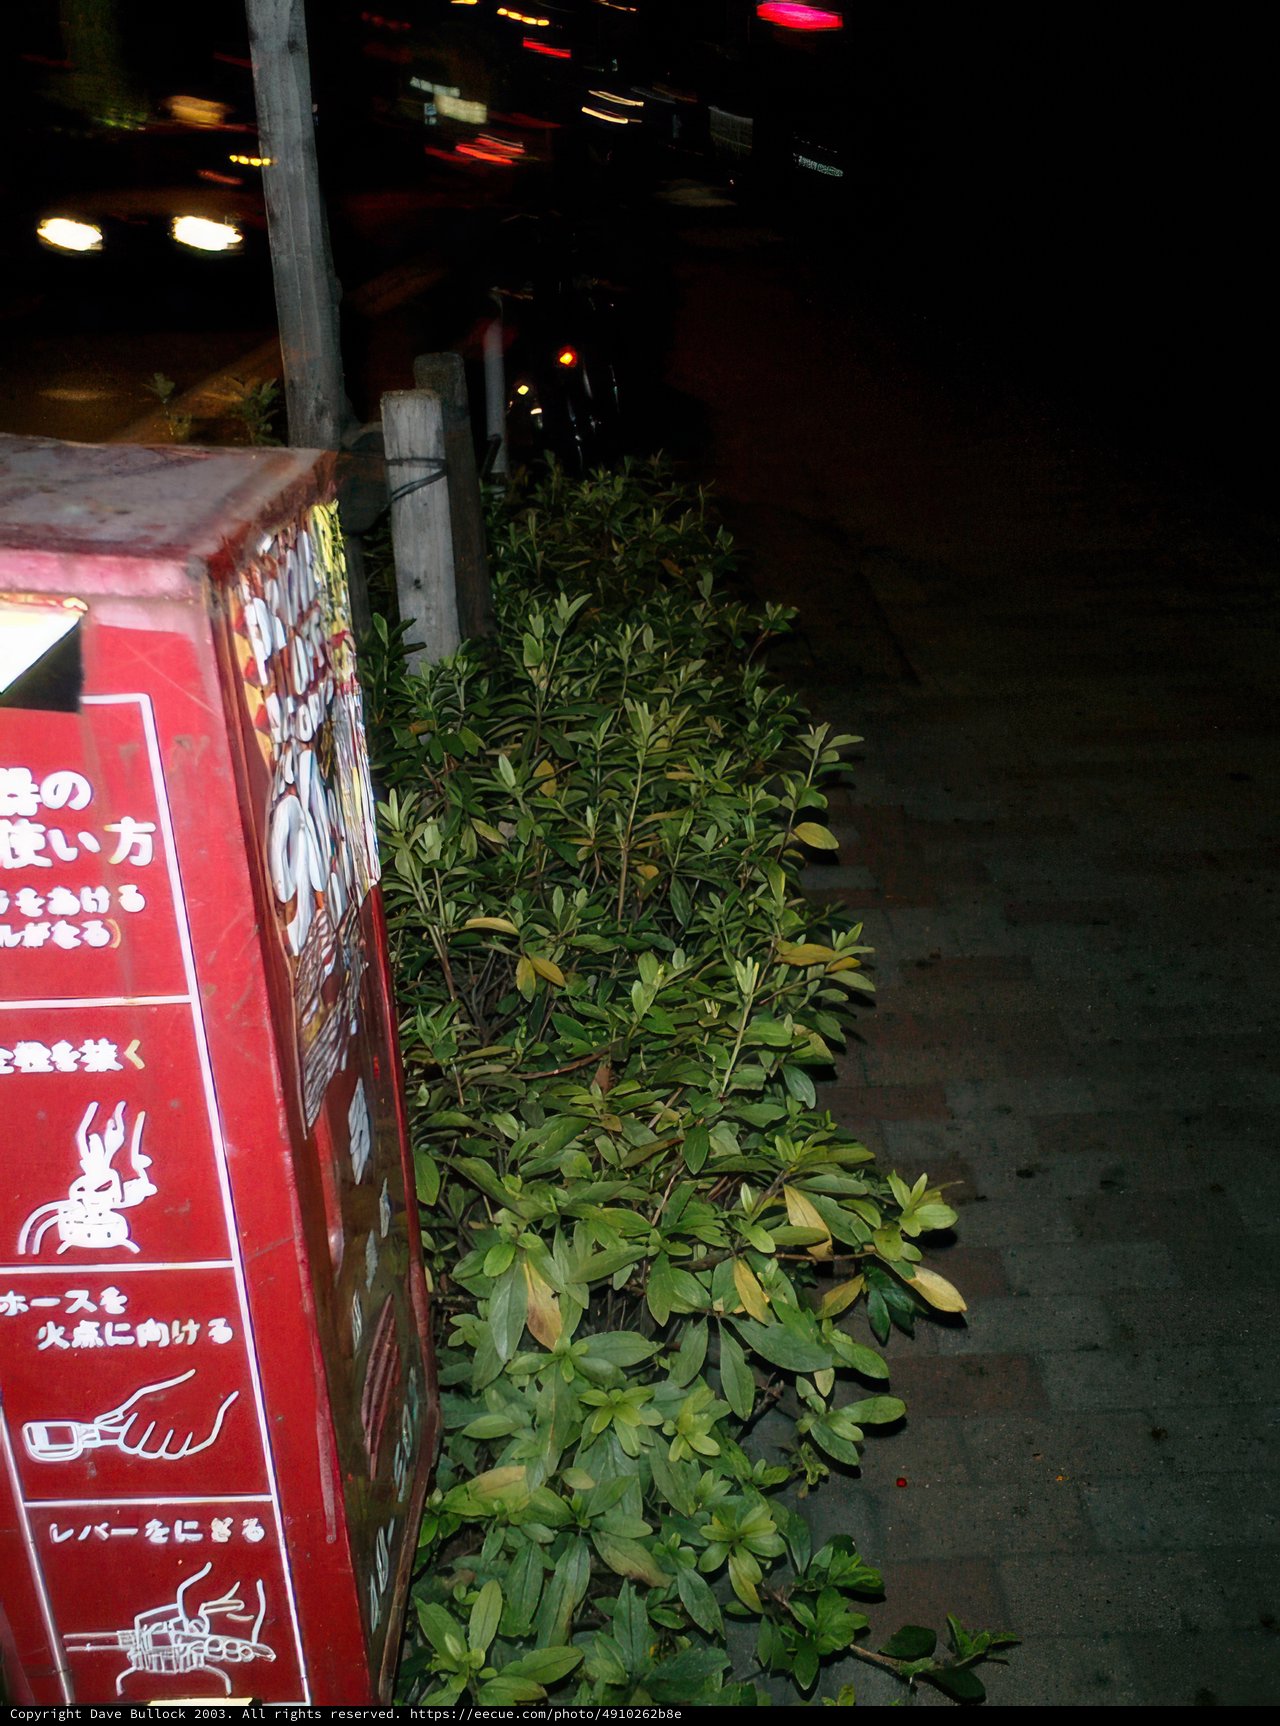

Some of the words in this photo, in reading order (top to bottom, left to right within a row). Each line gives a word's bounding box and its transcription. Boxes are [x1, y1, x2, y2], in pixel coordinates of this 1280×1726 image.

[0, 816, 156, 869] 使い方
[0, 1286, 128, 1316] ホースを
[37, 1317, 233, 1351] 火点に向ける
[49, 1517, 265, 1544] レバーをにぎる
